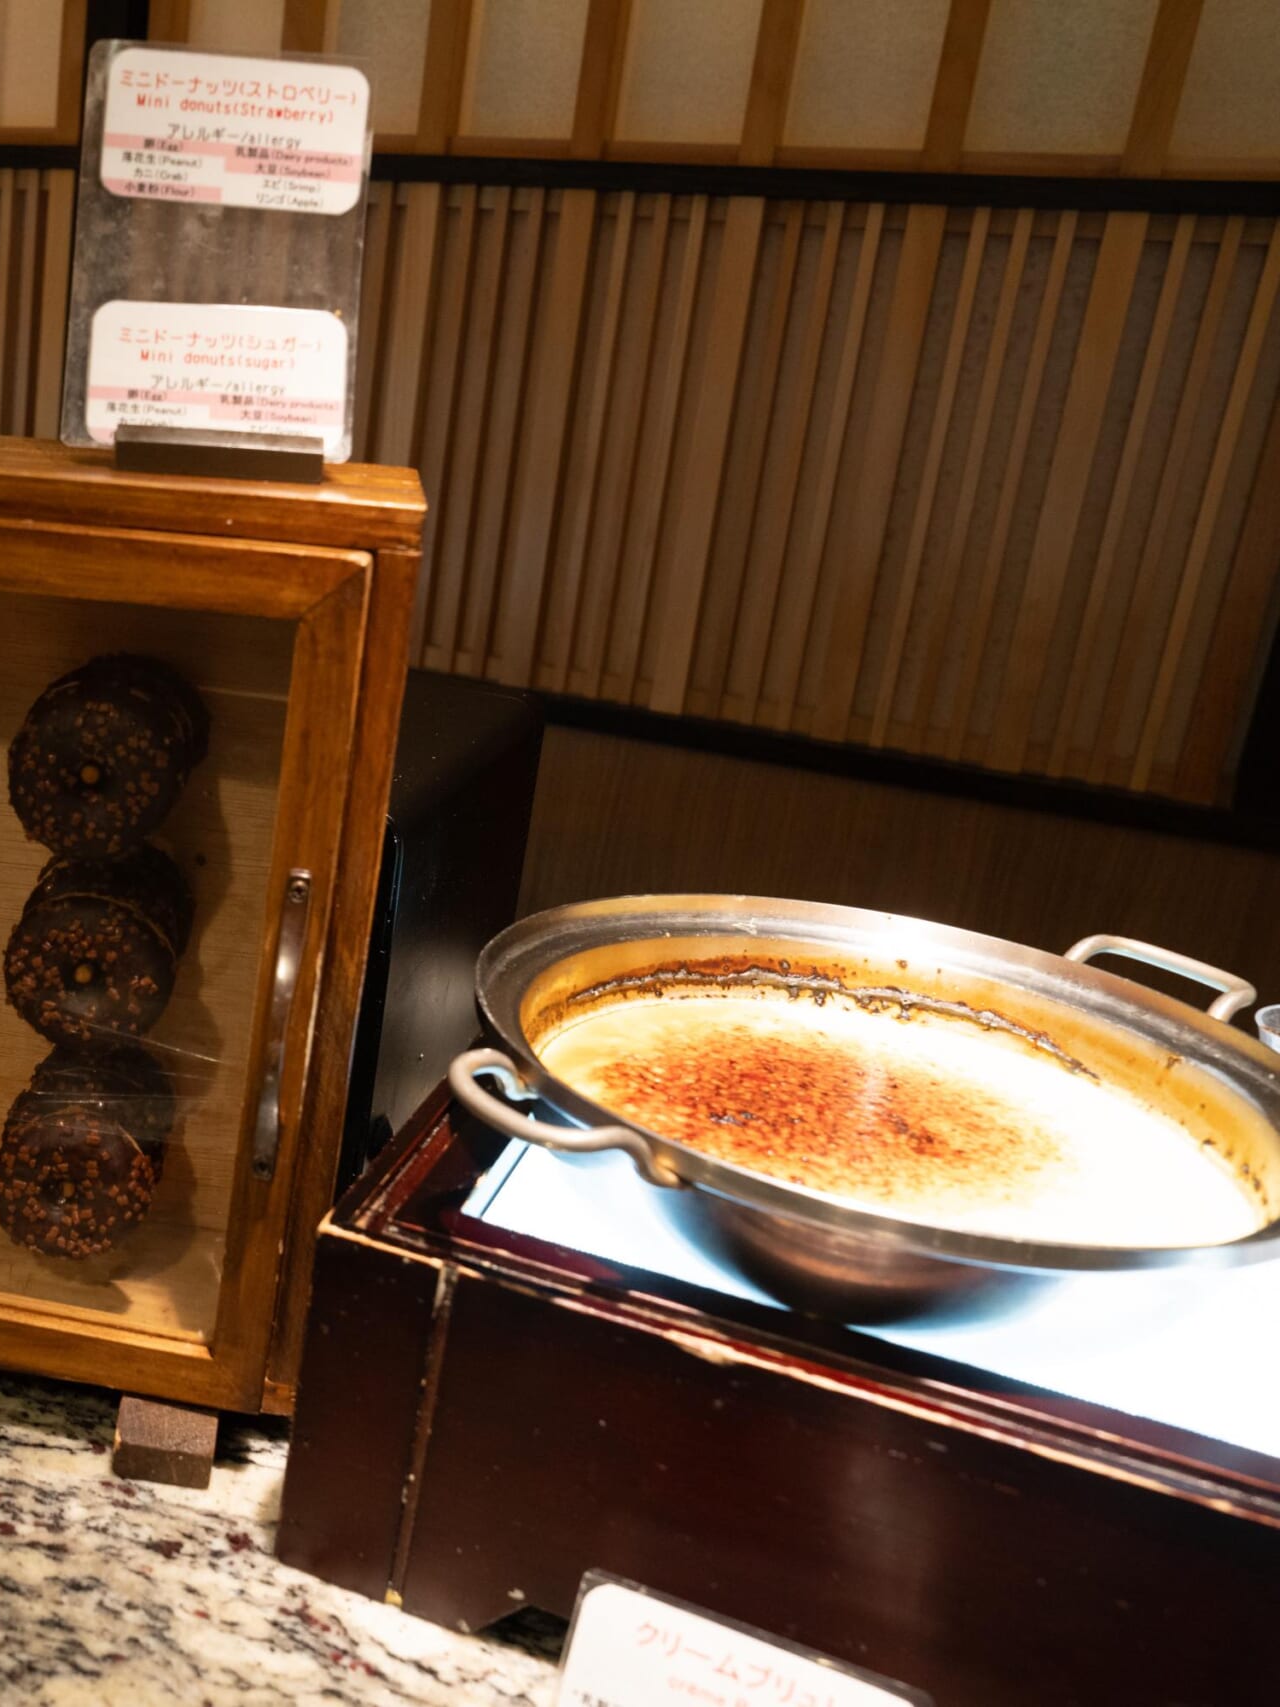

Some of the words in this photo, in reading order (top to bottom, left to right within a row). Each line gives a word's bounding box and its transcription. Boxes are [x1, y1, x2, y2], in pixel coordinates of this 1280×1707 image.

[120, 68, 358, 106] ミニドーナッツ(ストロベリー)
[136, 93, 171, 108] Mini
[180, 97, 335, 124] donuts(Strawberry)
[140, 350, 175, 363] Mini
